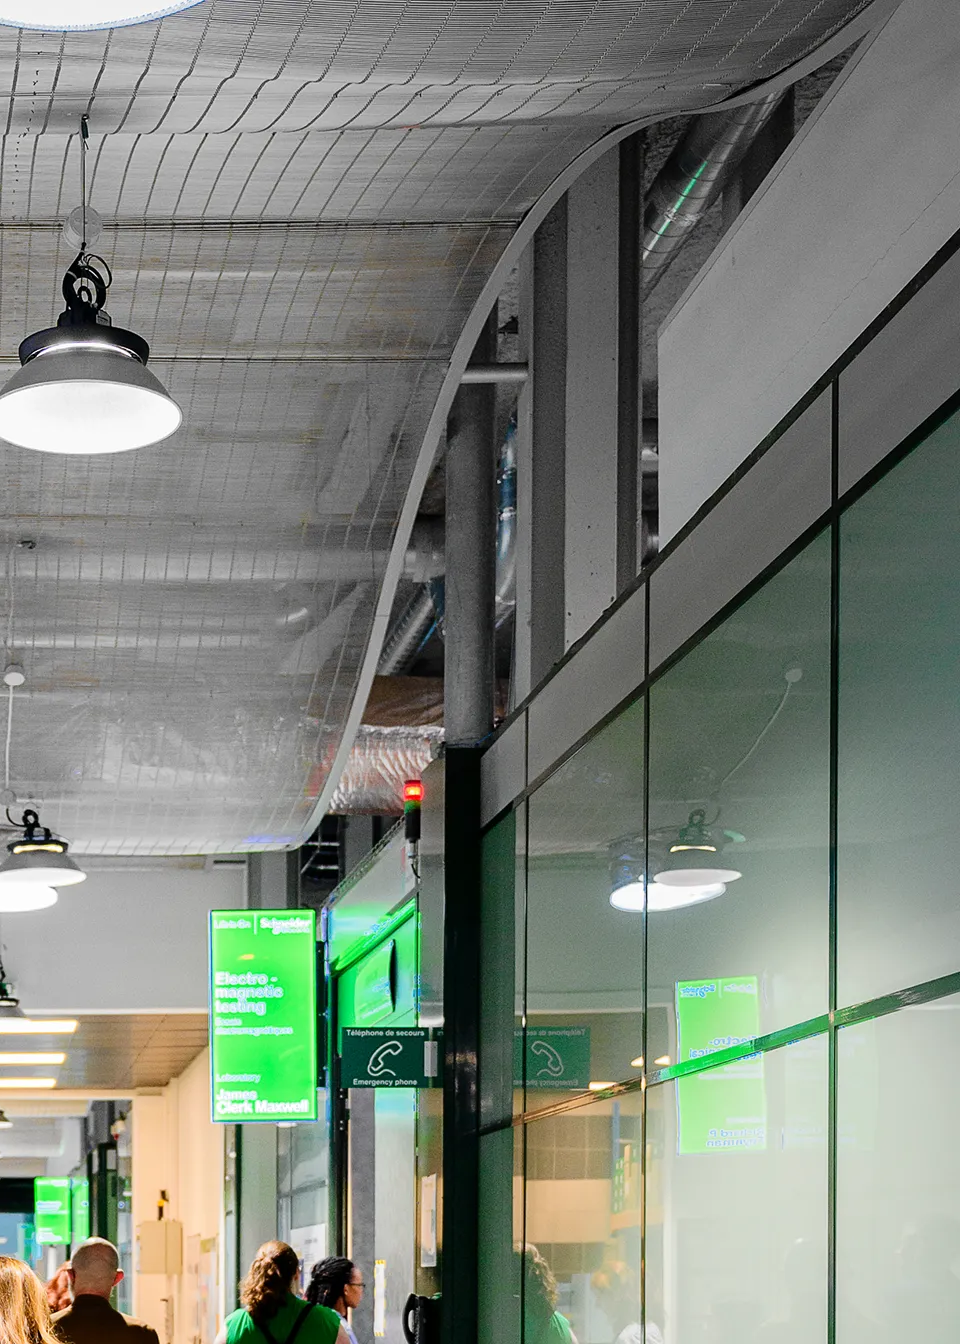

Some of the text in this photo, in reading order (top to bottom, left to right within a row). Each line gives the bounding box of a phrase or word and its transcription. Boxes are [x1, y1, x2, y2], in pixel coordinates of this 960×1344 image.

[215, 985, 284, 1002] magnetic
[215, 999, 267, 1016] testing
[345, 1029, 425, 1038] Téléphone de secours
[352, 1078, 418, 1087] Emergency phone
[215, 1088, 258, 1101] James
[215, 1098, 309, 1114] Clerk Maxwell
